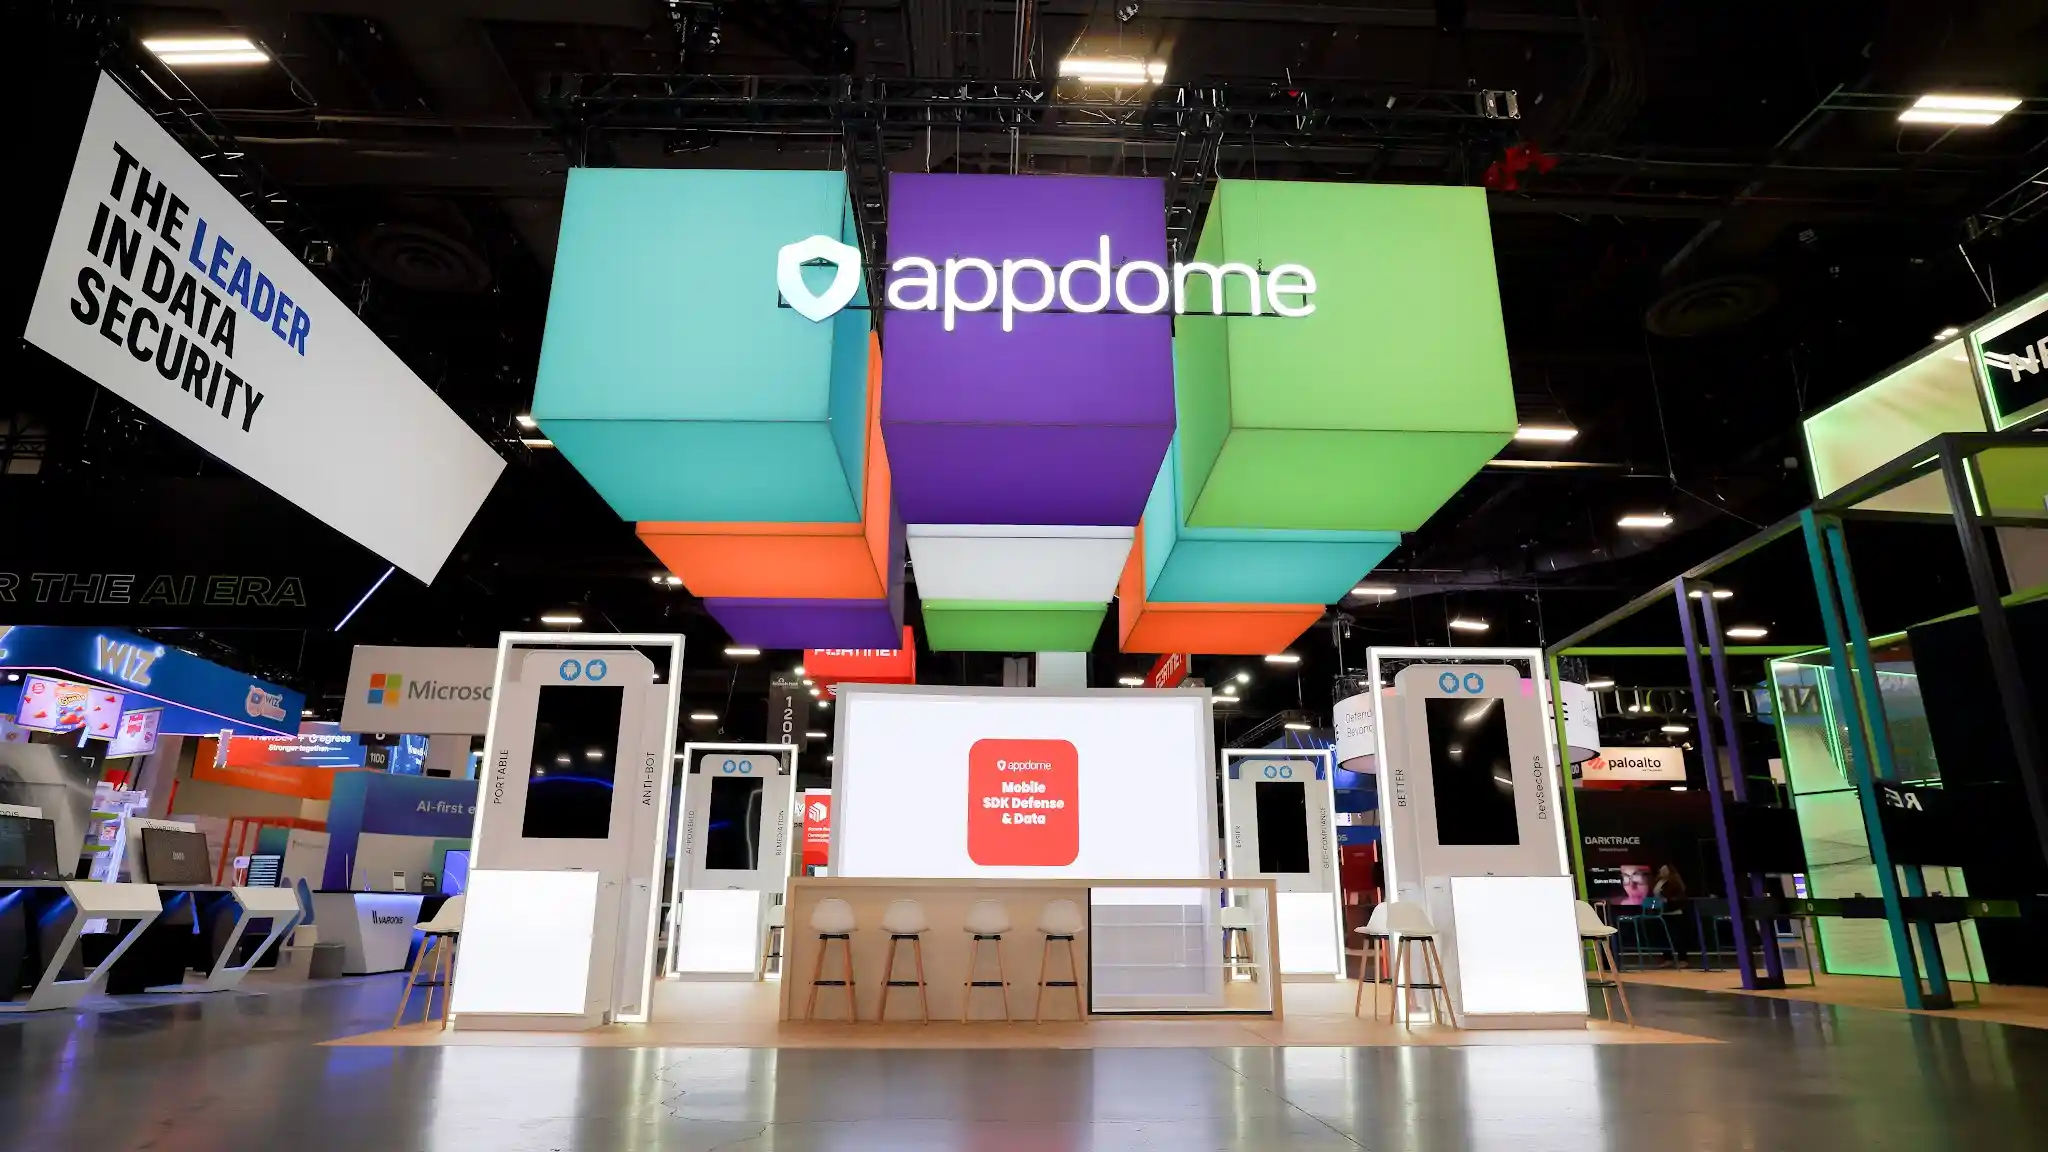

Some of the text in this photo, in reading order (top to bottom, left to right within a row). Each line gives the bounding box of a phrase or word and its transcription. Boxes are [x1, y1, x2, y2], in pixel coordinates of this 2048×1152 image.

[110, 140, 311, 356] THE LEADER
[87, 201, 237, 359] IN DATA
[887, 234, 1317, 332] appdome
[70, 266, 265, 432] SECURITY
[31, 573, 135, 604] THE
[139, 575, 196, 605] AI
[203, 576, 306, 607] ERA
[97, 634, 158, 686] WIZ
[782, 695, 793, 745] 1200
[268, 743, 300, 753] Stronger
[319, 735, 352, 745] egress
[370, 752, 385, 764] 1100
[1008, 760, 1052, 773] appdome
[1608, 757, 1661, 770] paloalto
[494, 749, 509, 804] PORTABLE
[642, 751, 655, 806] ANTI-BOT
[1001, 780, 1046, 793] Mobile
[1395, 769, 1407, 807] BETTER
[1532, 755, 1547, 819] DevSecOps
[416, 800, 464, 814] AI-first
[983, 796, 1065, 809] SDK Defense
[1002, 813, 1046, 825] & Data
[1584, 836, 1640, 845] DARKTRACE
